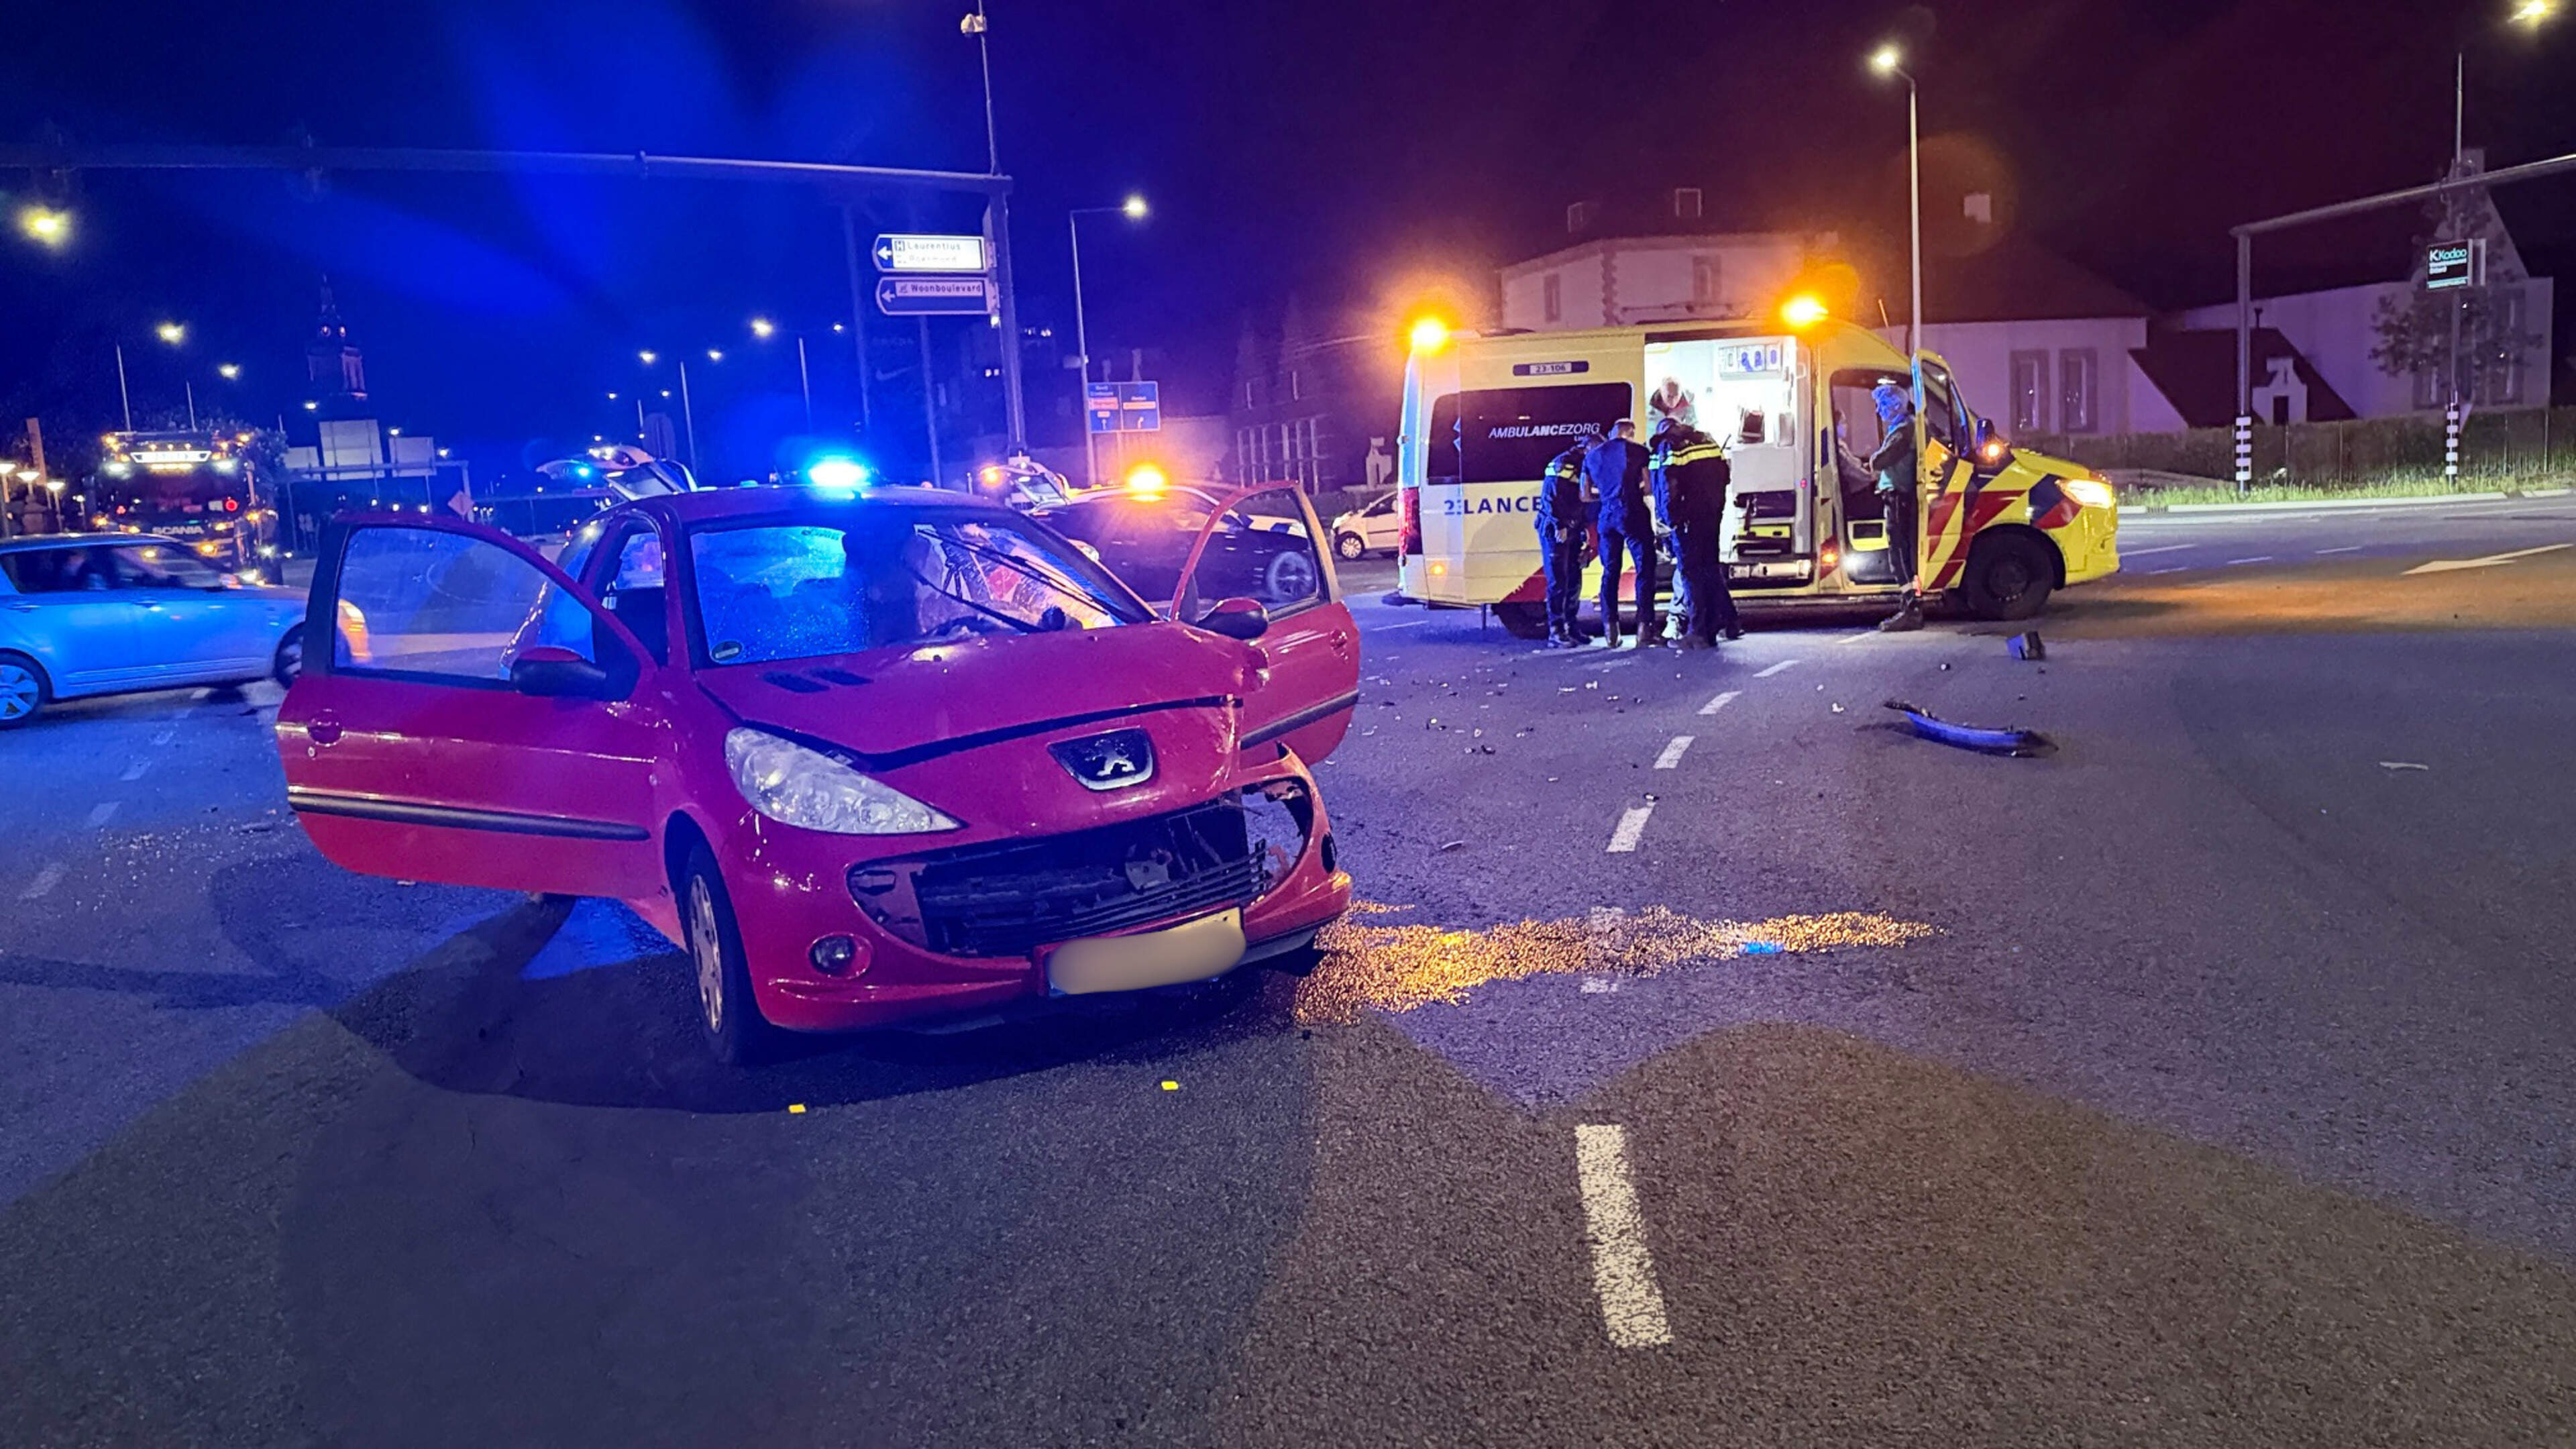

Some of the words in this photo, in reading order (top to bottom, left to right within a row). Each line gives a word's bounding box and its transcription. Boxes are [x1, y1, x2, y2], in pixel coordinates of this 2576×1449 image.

[911, 284, 981, 293] Woonboulevard
[1488, 423, 1601, 439] AMBULANCEZORG
[152, 525, 205, 535] SCANIA
